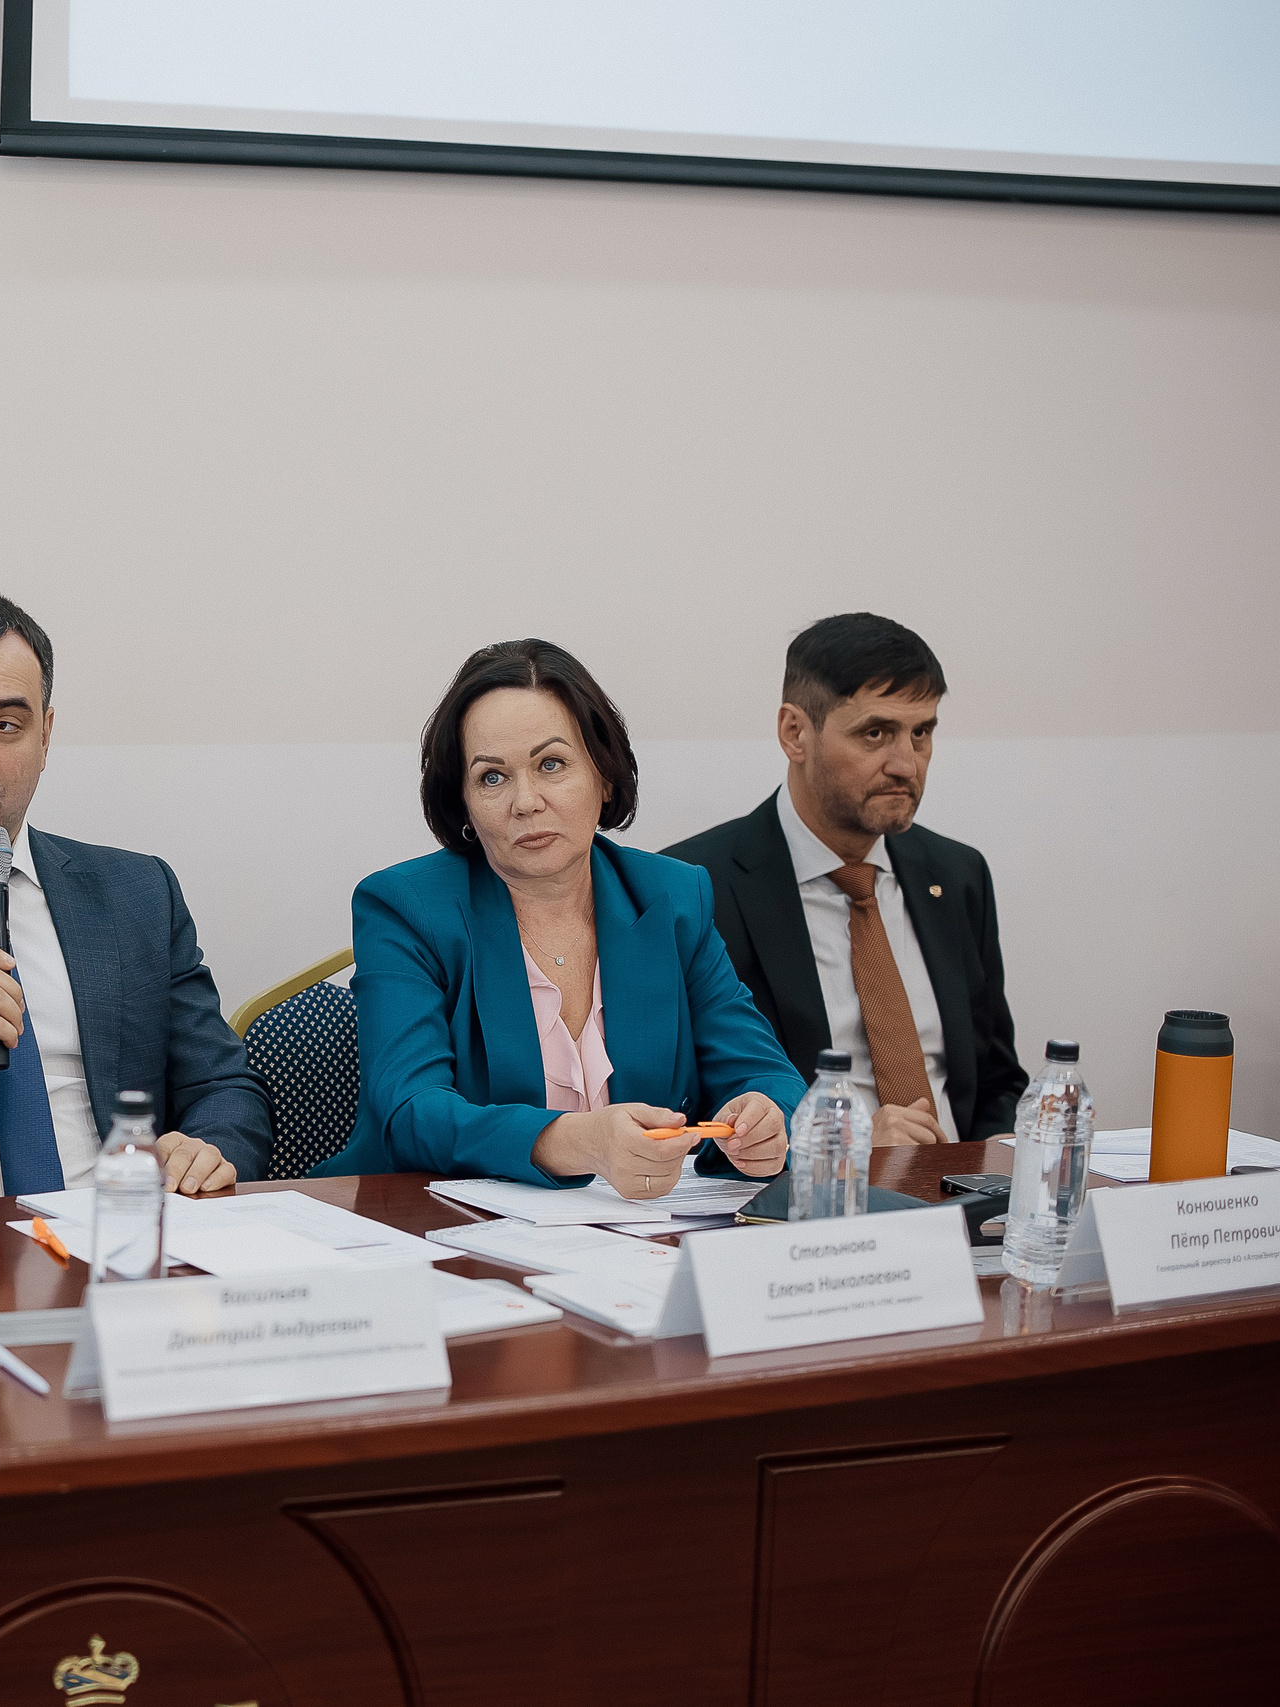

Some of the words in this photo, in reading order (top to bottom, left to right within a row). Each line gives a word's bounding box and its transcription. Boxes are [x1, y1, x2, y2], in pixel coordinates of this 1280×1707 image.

[1177, 1195, 1259, 1215] Конюшенко
[1170, 1233, 1209, 1249] Пётр
[1232, 1255, 1241, 1263] АО
